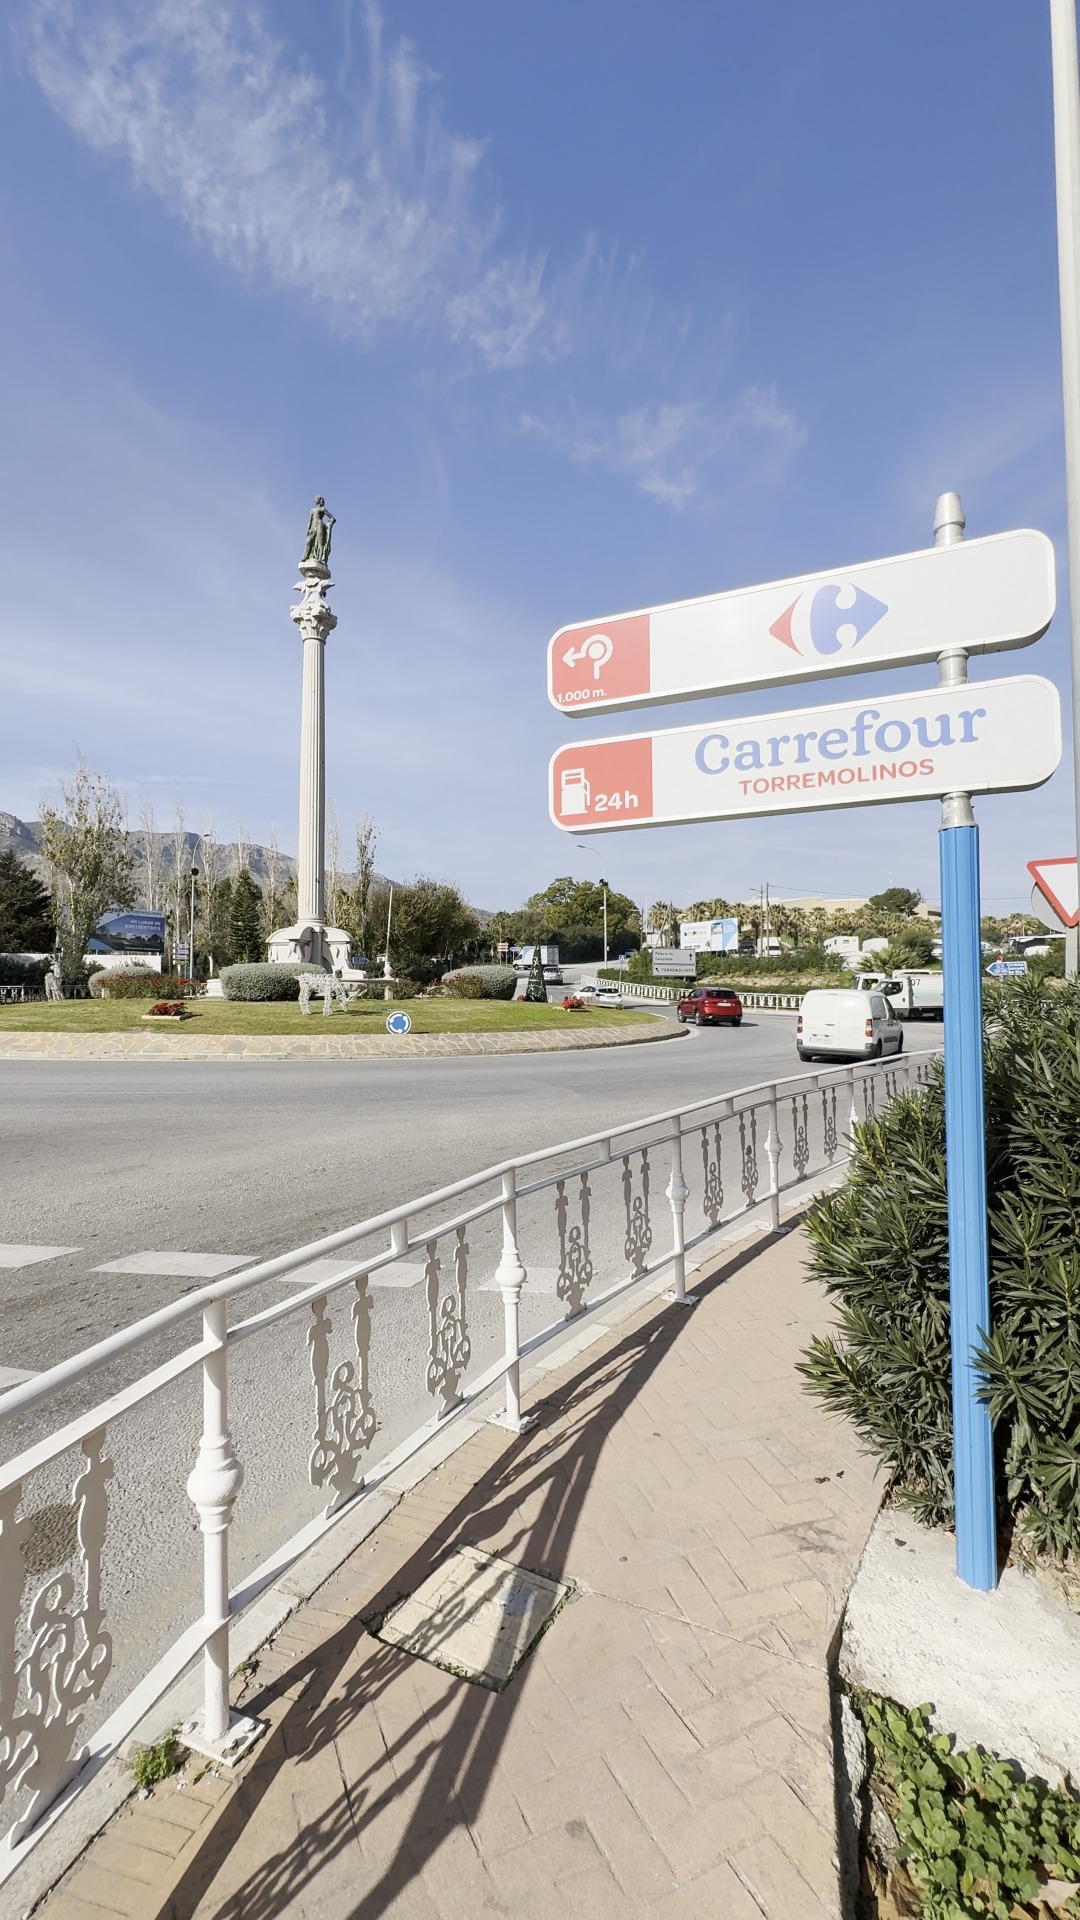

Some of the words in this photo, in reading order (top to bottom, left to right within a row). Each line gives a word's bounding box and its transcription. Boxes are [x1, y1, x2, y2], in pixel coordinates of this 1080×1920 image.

[557, 689, 590, 703] 1.000
[592, 688, 608, 698] m.
[694, 707, 987, 775] Carrefour
[738, 758, 935, 796] TORREMOLINOS
[594, 790, 639, 812] 24h
